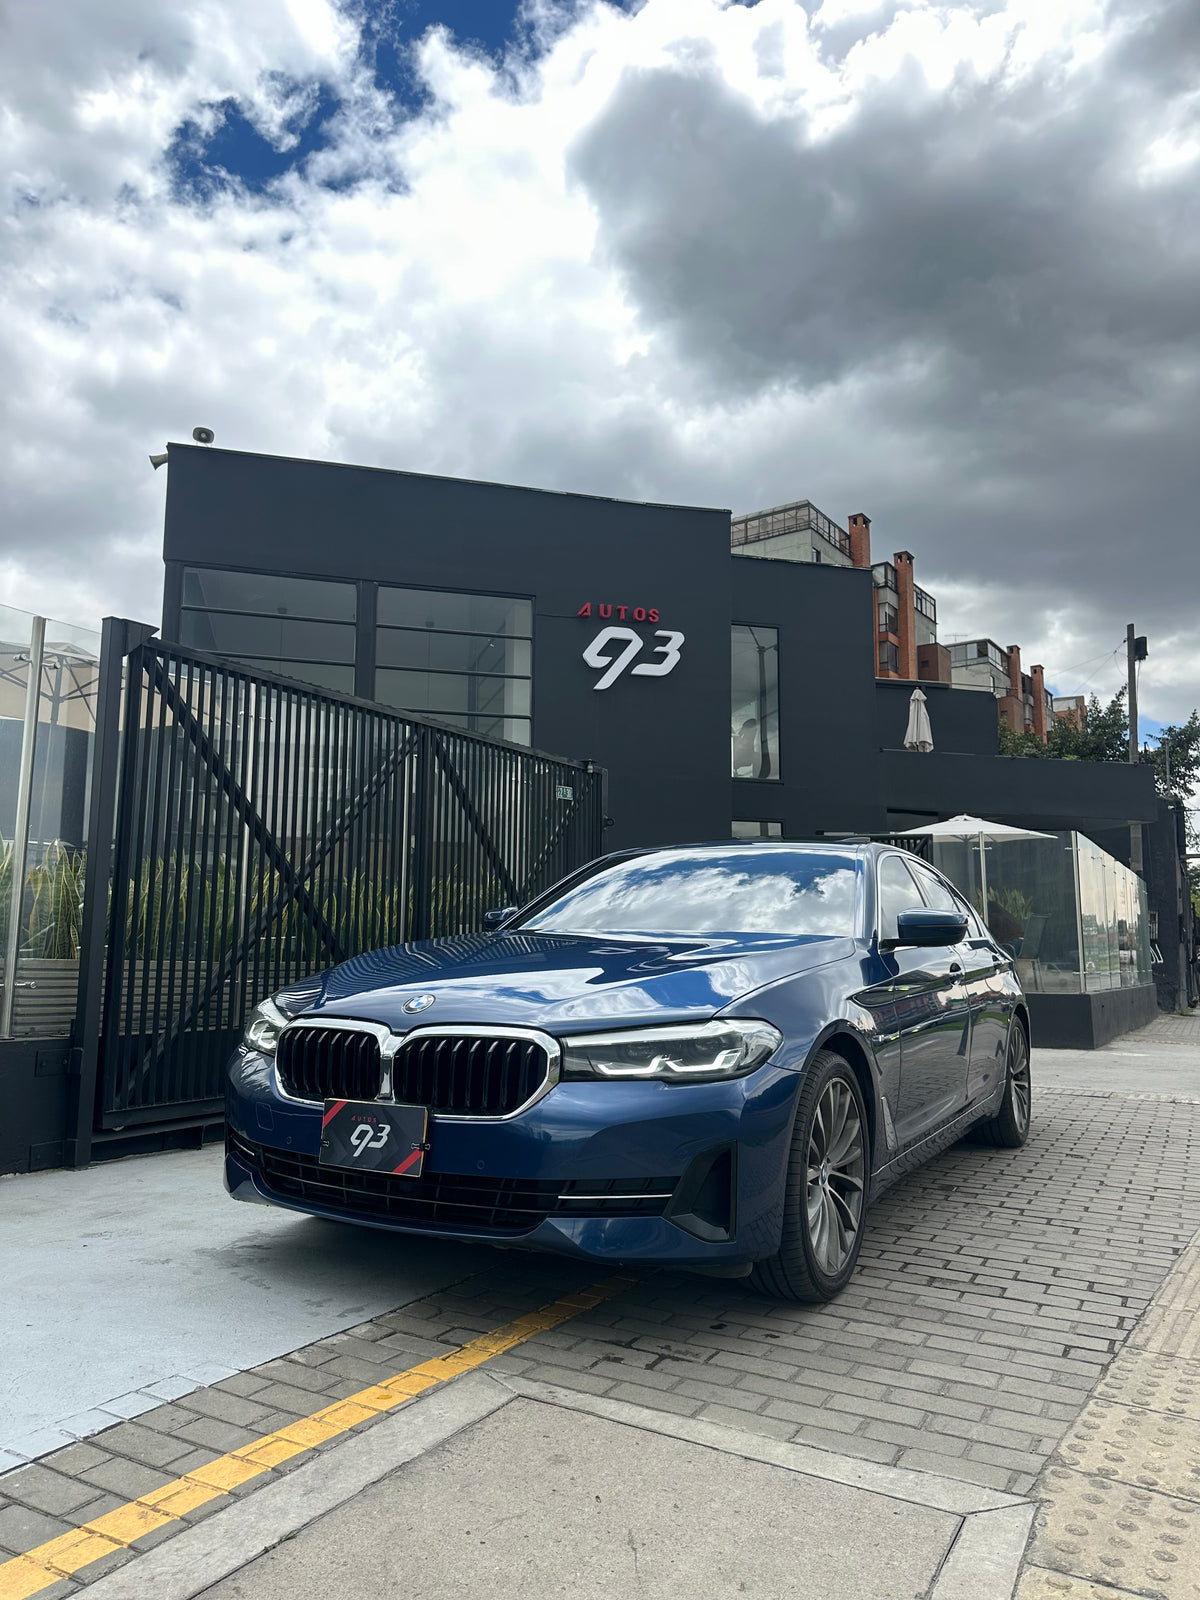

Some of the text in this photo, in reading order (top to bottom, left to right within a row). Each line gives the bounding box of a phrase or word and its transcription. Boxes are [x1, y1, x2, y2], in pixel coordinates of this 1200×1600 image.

[576, 602, 660, 622] AUTOS
[582, 626, 685, 691] 93
[350, 1124, 391, 1157] 93
